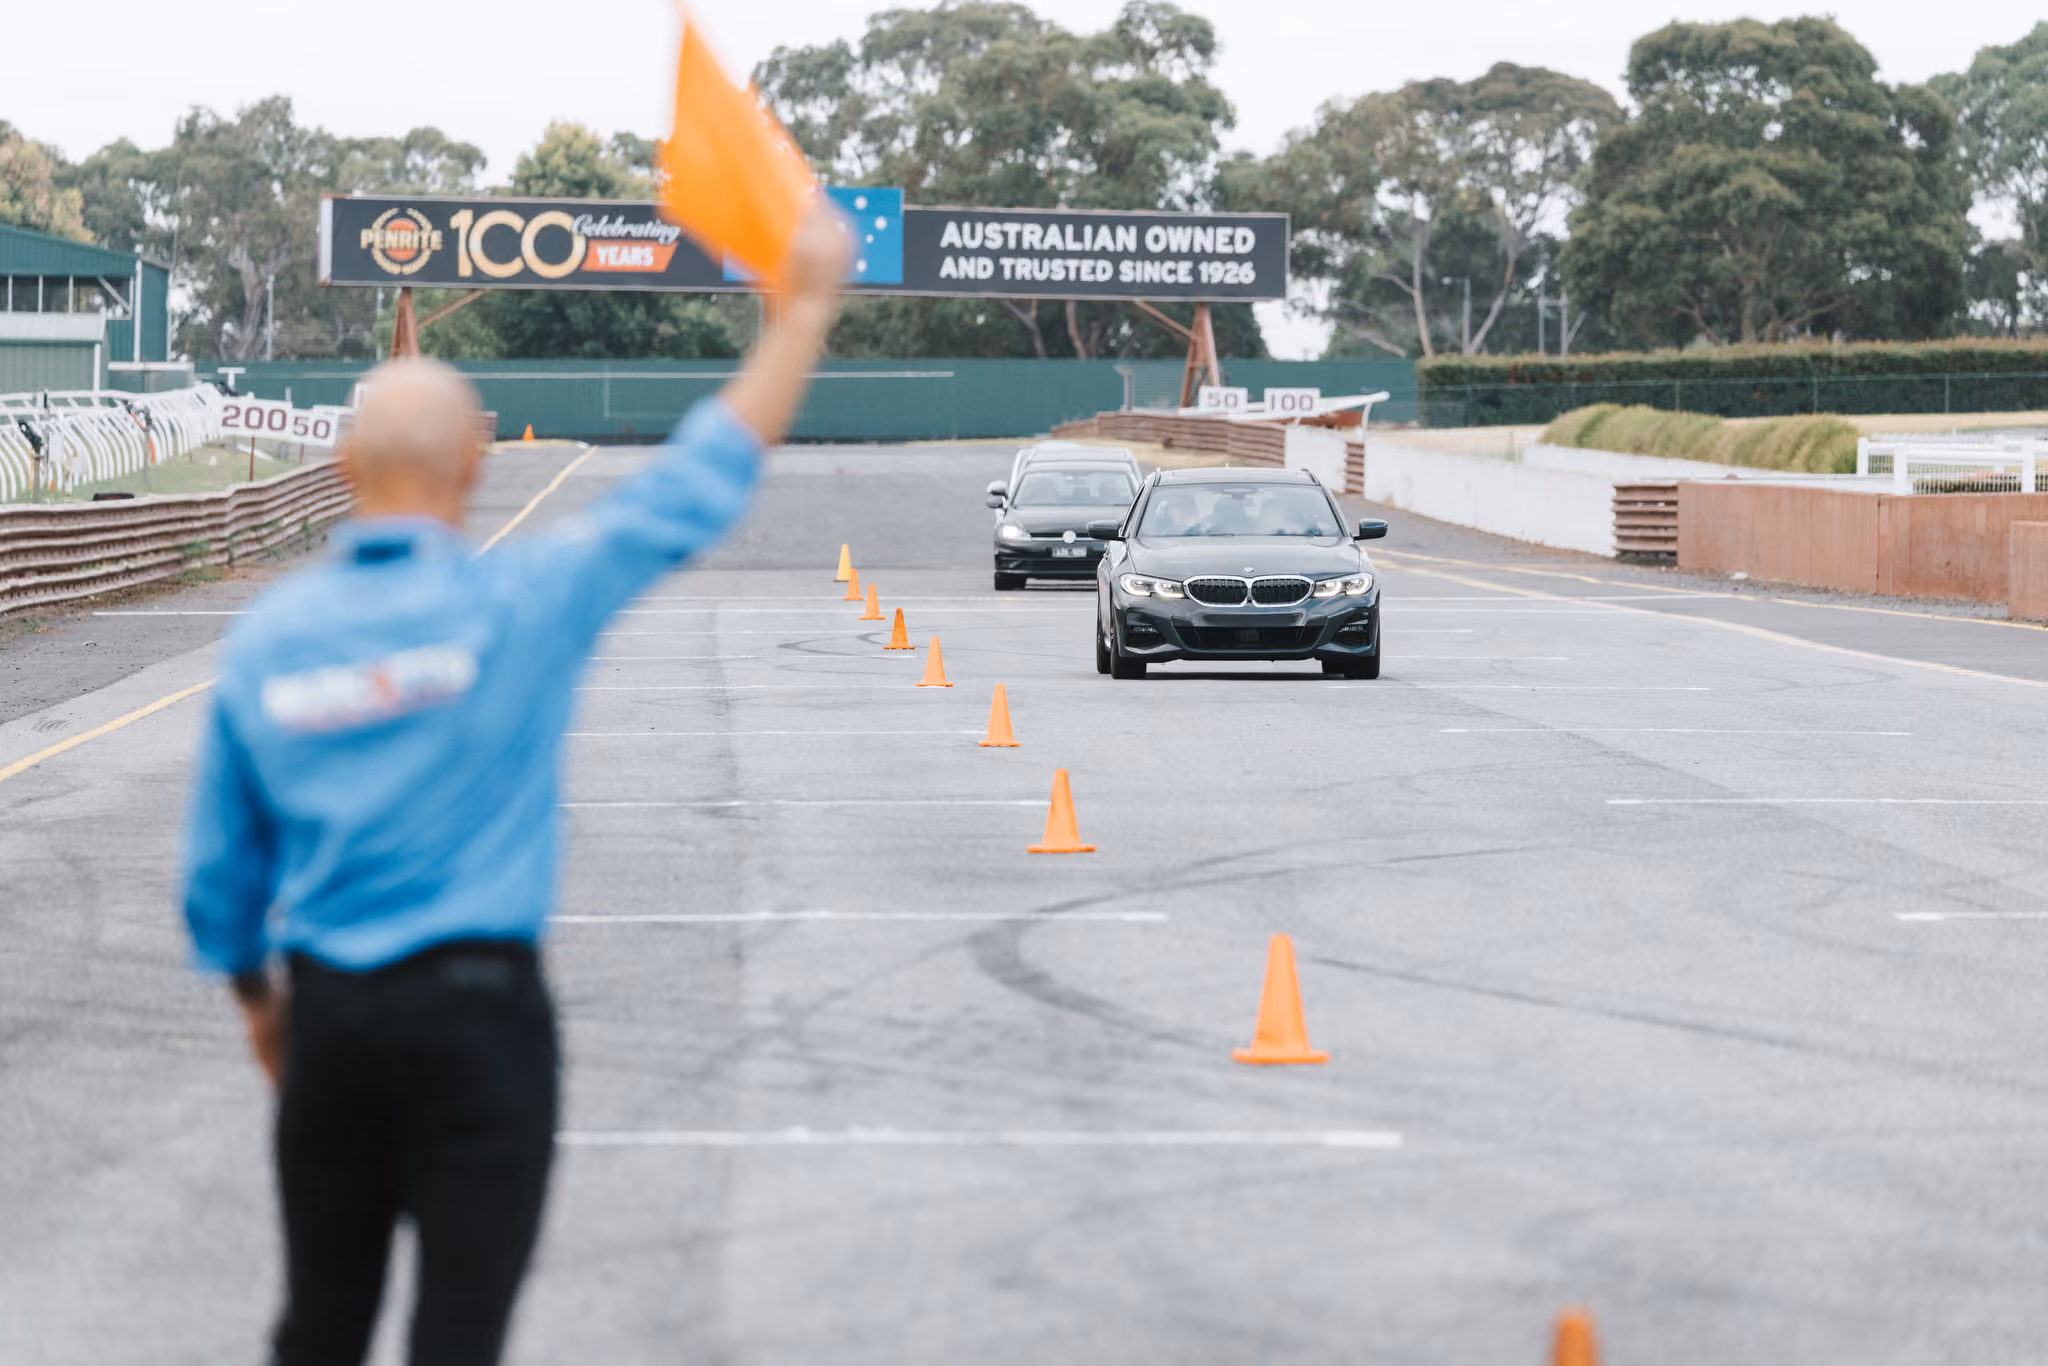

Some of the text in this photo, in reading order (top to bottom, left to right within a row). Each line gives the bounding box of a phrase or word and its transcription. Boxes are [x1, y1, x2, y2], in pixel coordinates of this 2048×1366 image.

[360, 229, 443, 251] PENRITE
[572, 214, 682, 245] Celebrating
[939, 221, 1256, 254] AUSTRALIAN OWNED
[449, 208, 587, 279] 100
[597, 246, 654, 267] YEARS
[939, 256, 1256, 285] AND TRUSTED SINCE 1926
[1207, 392, 1238, 408] 50
[1270, 394, 1314, 412] 100
[221, 405, 287, 431] 200
[293, 416, 331, 439] 50
